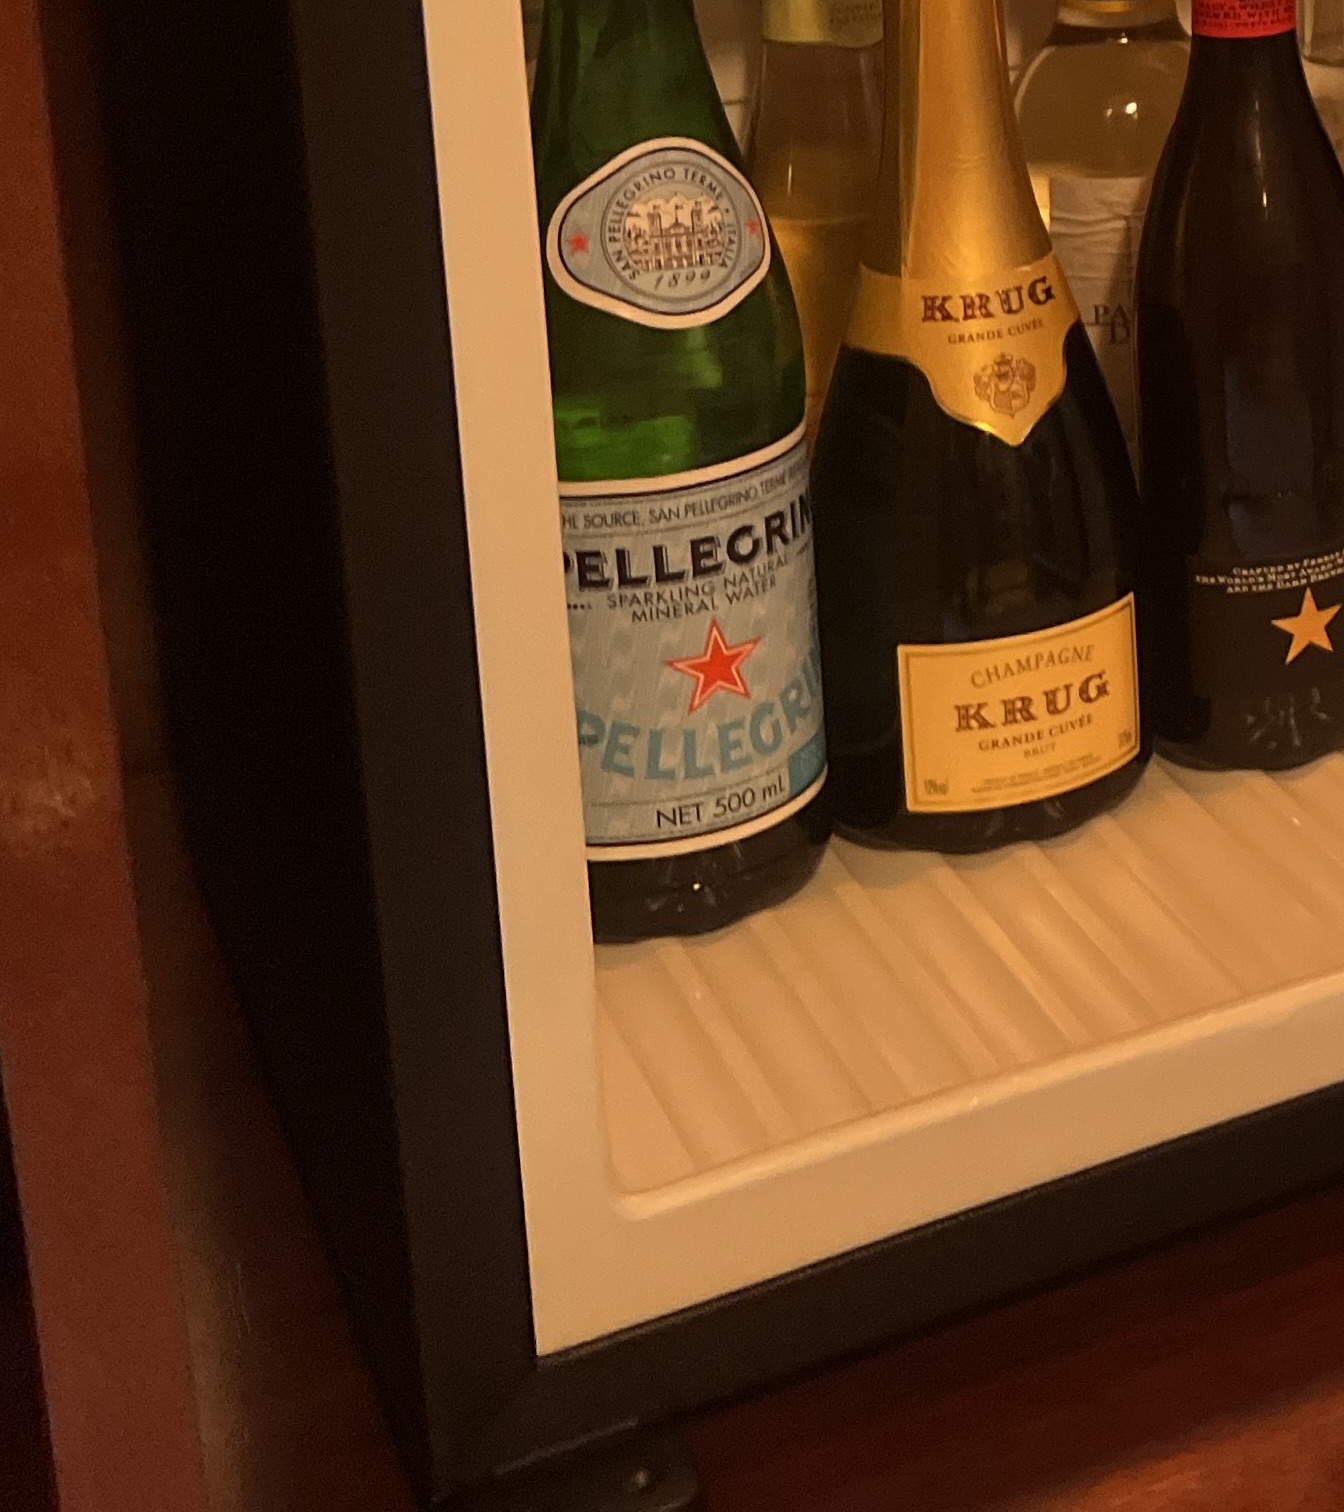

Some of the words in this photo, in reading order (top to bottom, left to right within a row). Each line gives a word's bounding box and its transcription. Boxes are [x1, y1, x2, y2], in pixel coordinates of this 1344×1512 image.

[608, 167, 677, 244] PELLEGRINO
[683, 167, 724, 202] TERME
[616, 248, 642, 281] SAN
[921, 275, 1056, 324] KRUG
[947, 328, 1004, 345] GRANDE
[649, 505, 681, 525] SAN
[683, 485, 758, 517] PELLEGRINO
[606, 582, 717, 611] SPARKLING
[722, 555, 790, 588] NATURAL
[630, 596, 719, 624] MINERAL
[724, 575, 778, 605] WATER
[969, 643, 1097, 689] CHAMPAGNE
[953, 669, 1111, 734] KRUG
[978, 728, 1045, 752] GRANDE
[656, 801, 704, 829] NET
[713, 787, 756, 819] 500
